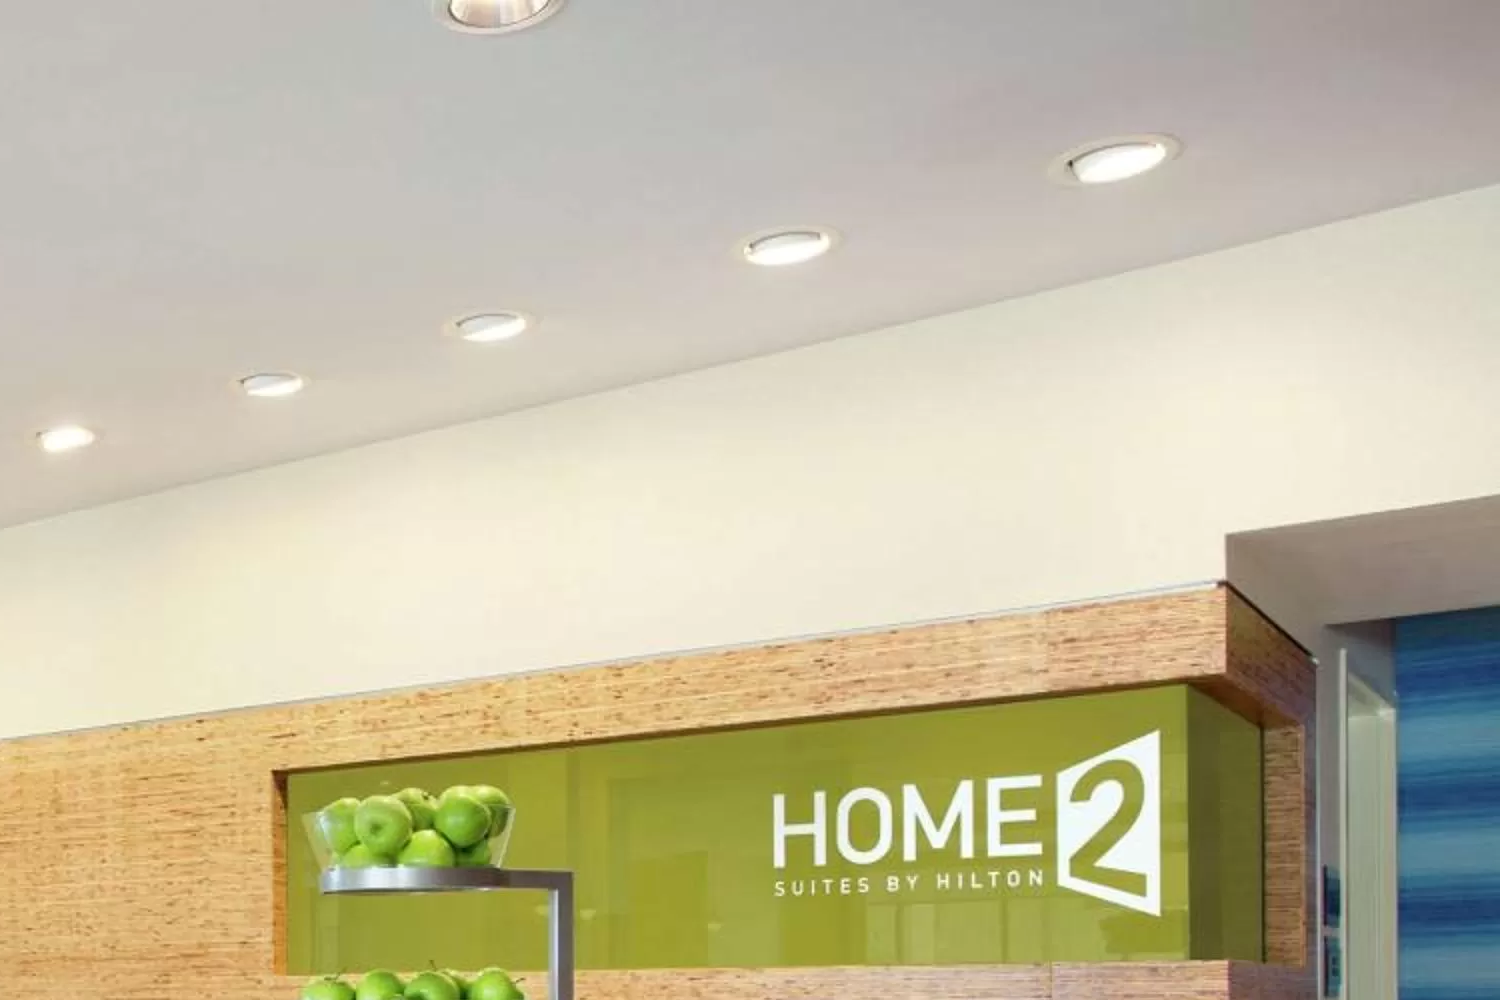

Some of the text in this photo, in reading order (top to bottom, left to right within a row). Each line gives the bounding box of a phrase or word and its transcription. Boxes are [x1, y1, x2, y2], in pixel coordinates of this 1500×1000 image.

[773, 869, 1044, 897] SUITES BY HILTON
